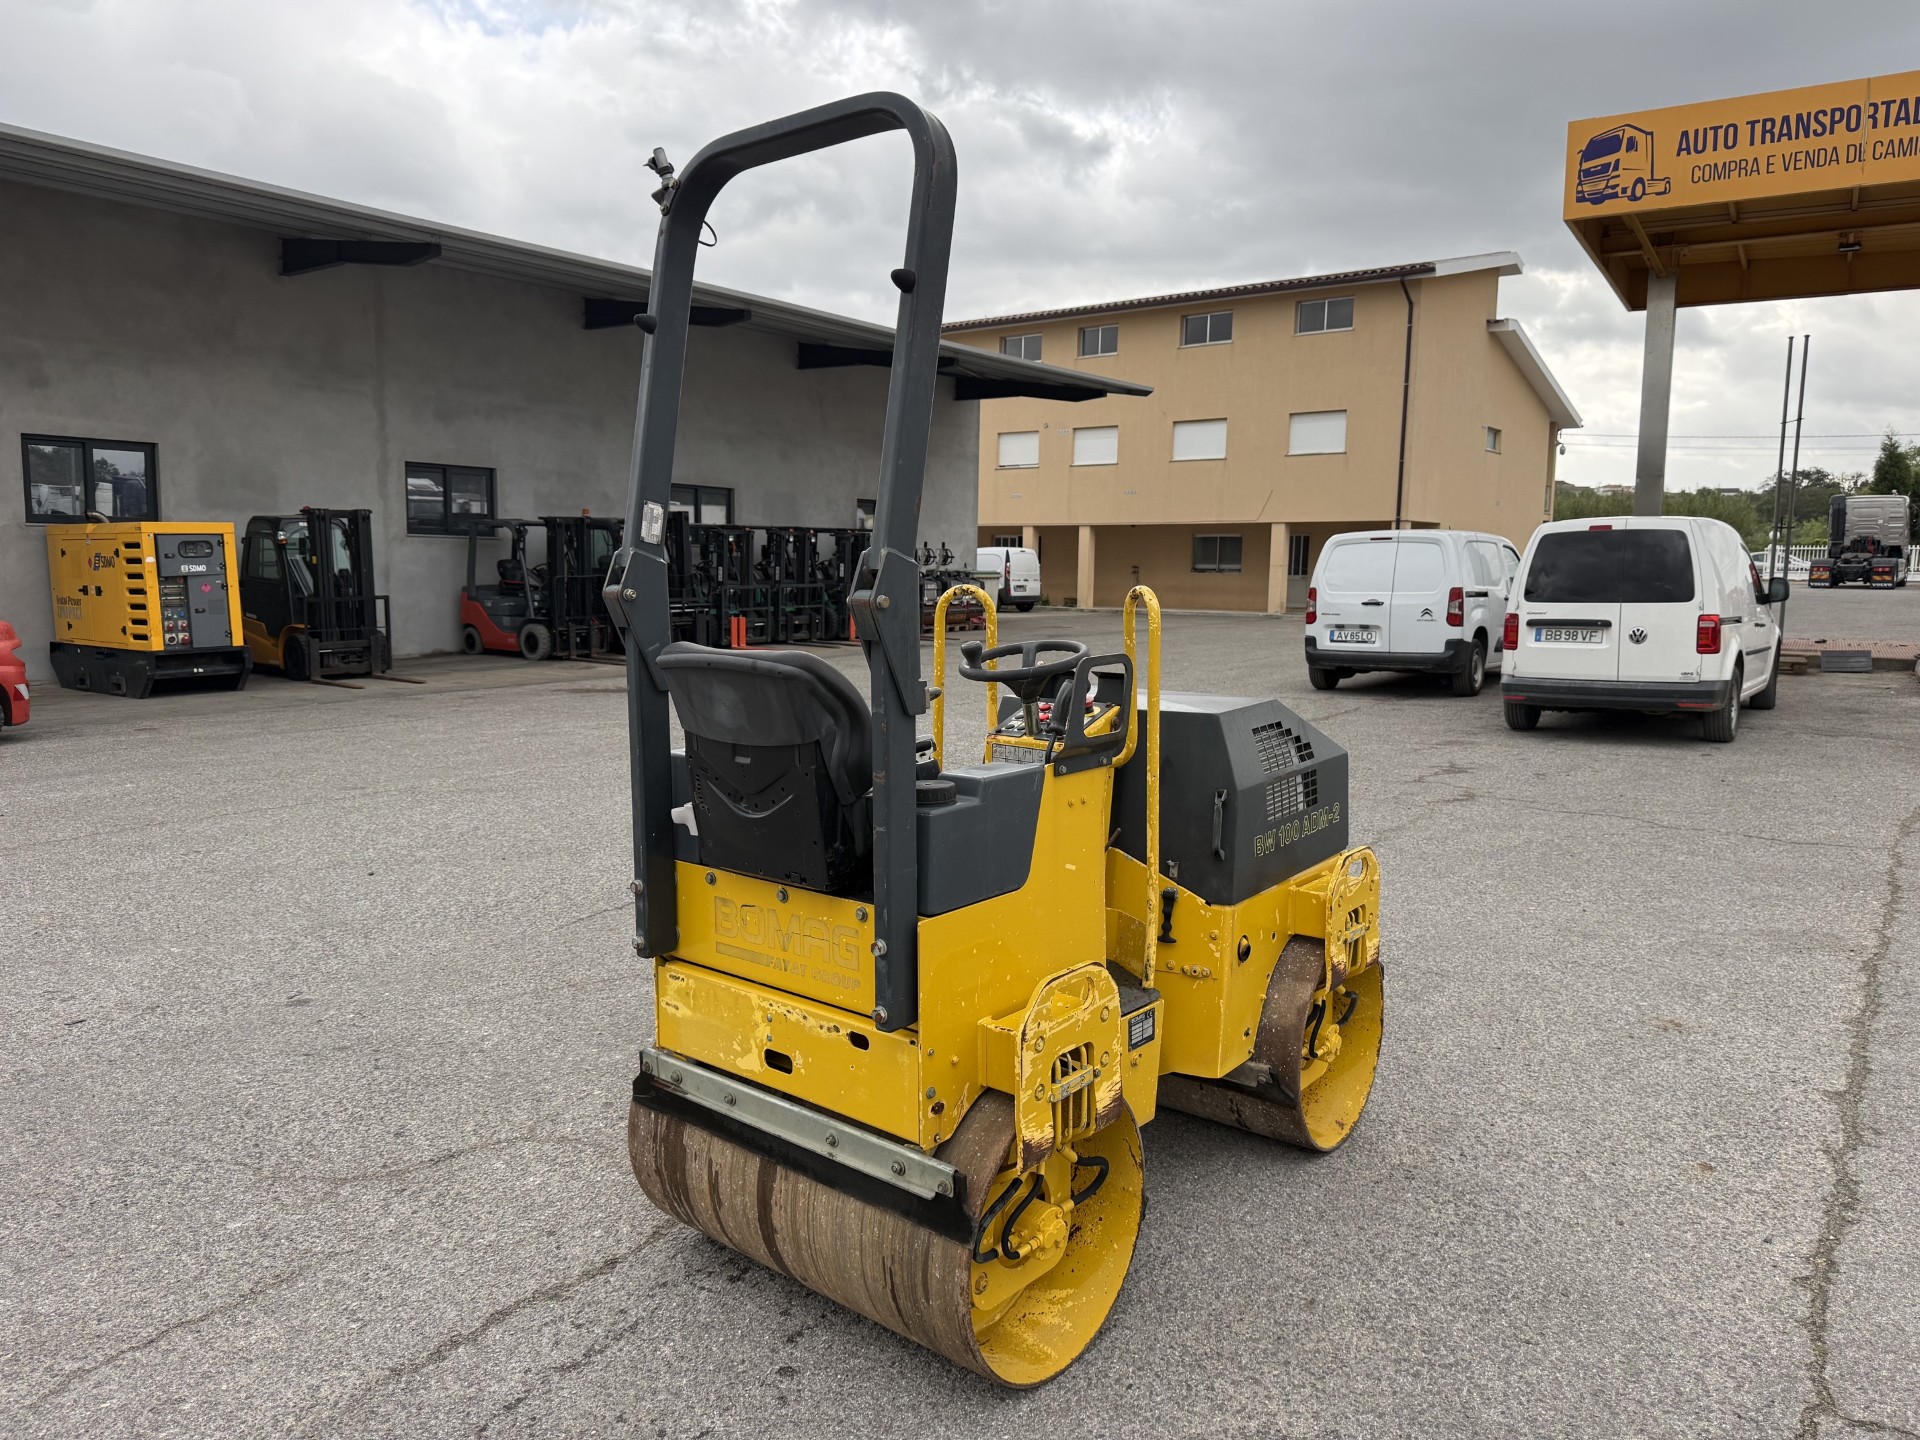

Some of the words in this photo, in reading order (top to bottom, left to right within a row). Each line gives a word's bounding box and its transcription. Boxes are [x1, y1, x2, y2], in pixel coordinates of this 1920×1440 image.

[1676, 123, 1738, 157] AUTO
[1691, 157, 1760, 184] COMPRA
[1766, 154, 1776, 174] E
[1782, 146, 1840, 172] VENDA
[1872, 136, 1920, 161] CAMI
[189, 564, 207, 573] SDMO
[1254, 829, 1277, 857] BW
[1279, 820, 1300, 847] 100
[1302, 802, 1340, 838] ADM-2
[714, 896, 860, 971] BOMAG
[811, 967, 861, 992] GROUP
